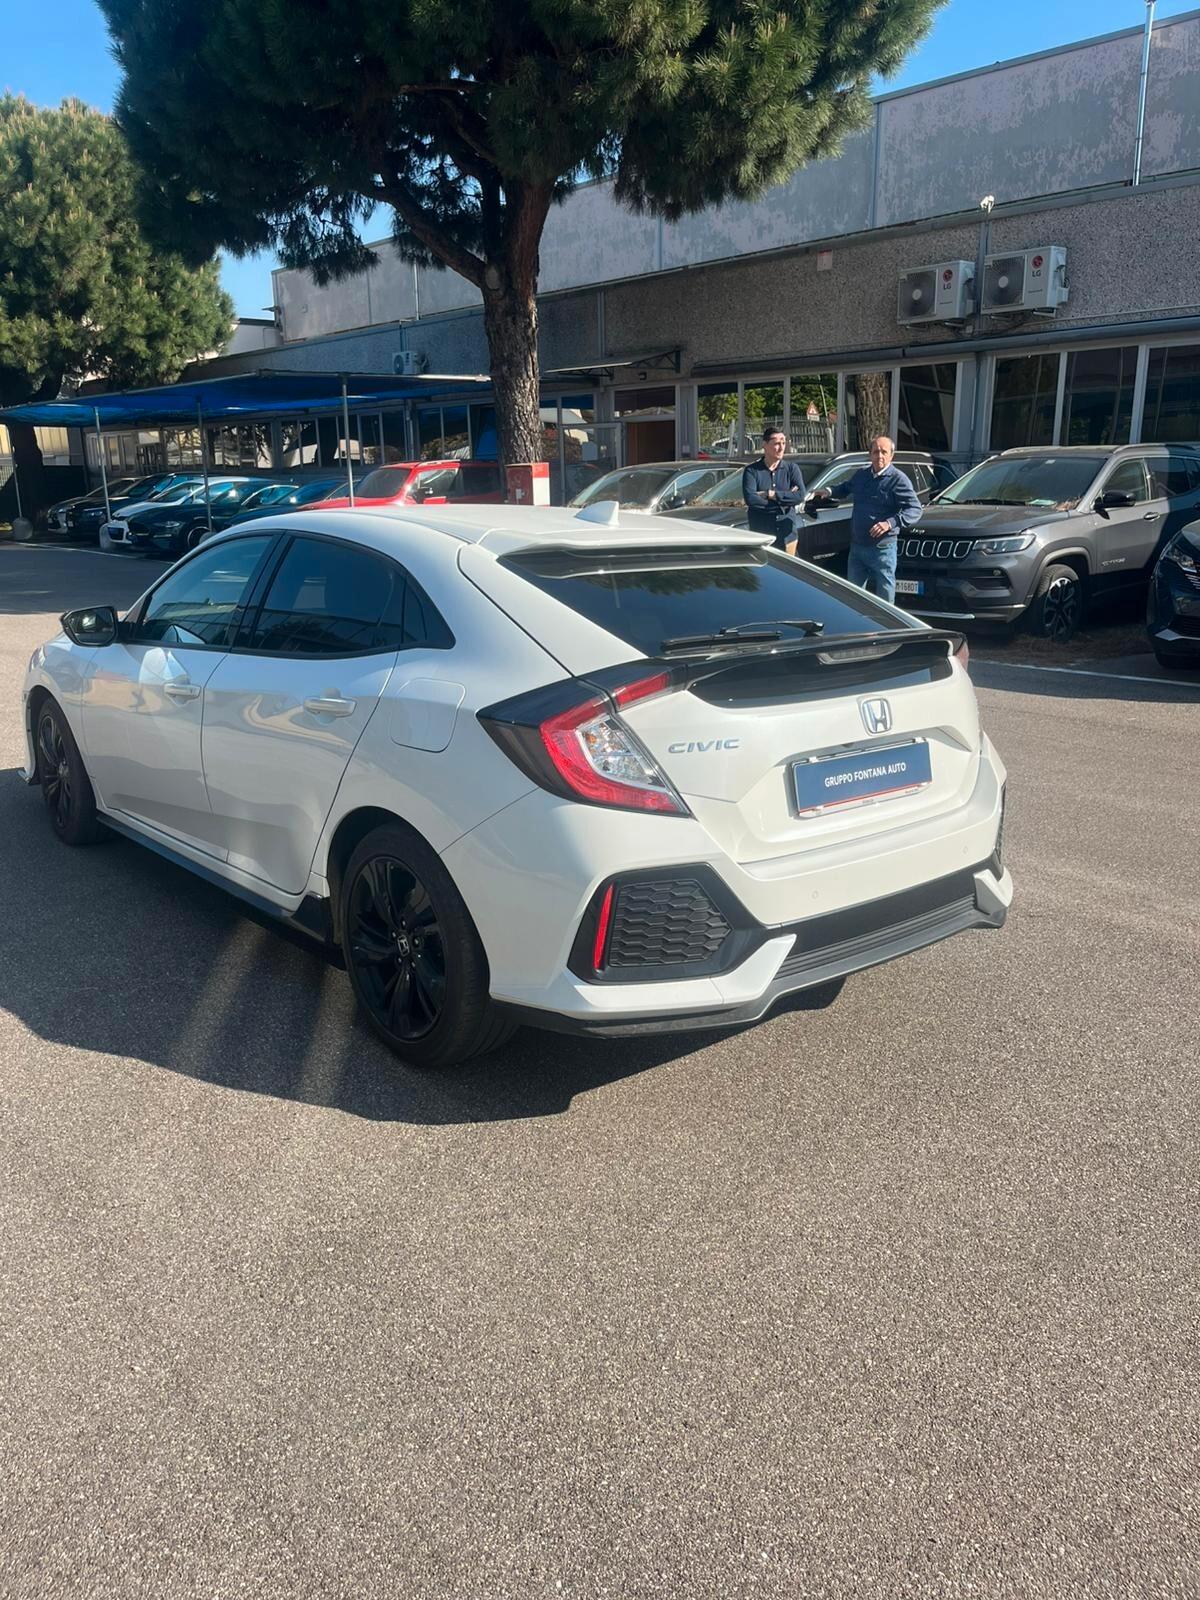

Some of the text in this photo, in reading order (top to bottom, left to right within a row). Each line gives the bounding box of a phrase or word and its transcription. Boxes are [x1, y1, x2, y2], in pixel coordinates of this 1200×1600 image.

[1031, 269, 1041, 278] LG
[943, 282, 952, 291] LG
[668, 738, 740, 754] CIVIC
[824, 762, 907, 788] GRUPPO FONTANA AUTO
